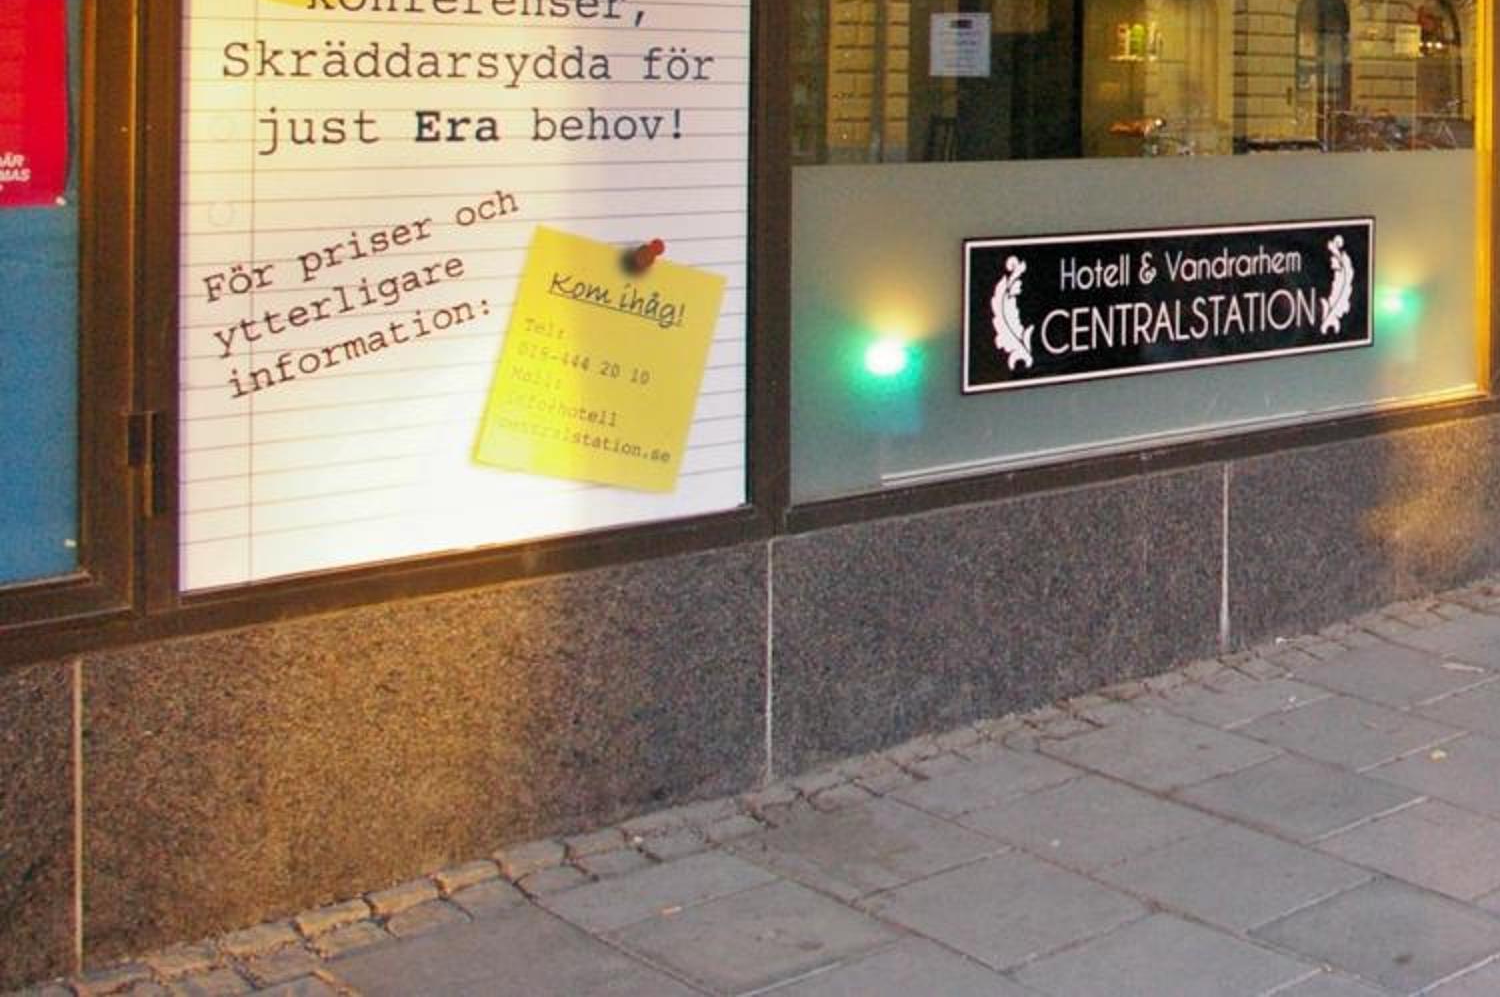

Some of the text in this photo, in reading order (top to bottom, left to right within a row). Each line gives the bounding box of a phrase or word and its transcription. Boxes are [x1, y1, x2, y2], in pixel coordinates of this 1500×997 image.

[222, 41, 715, 89] Skräddarsydda för
[257, 108, 685, 156] just Era behov!
[203, 188, 521, 304] För priser och
[1061, 247, 1302, 292] Hotell & Vandrarhem
[213, 254, 467, 359] ytterligare
[550, 271, 612, 305] Kom
[228, 299, 494, 399] information:
[1041, 287, 1317, 356] CENTRALSTATION
